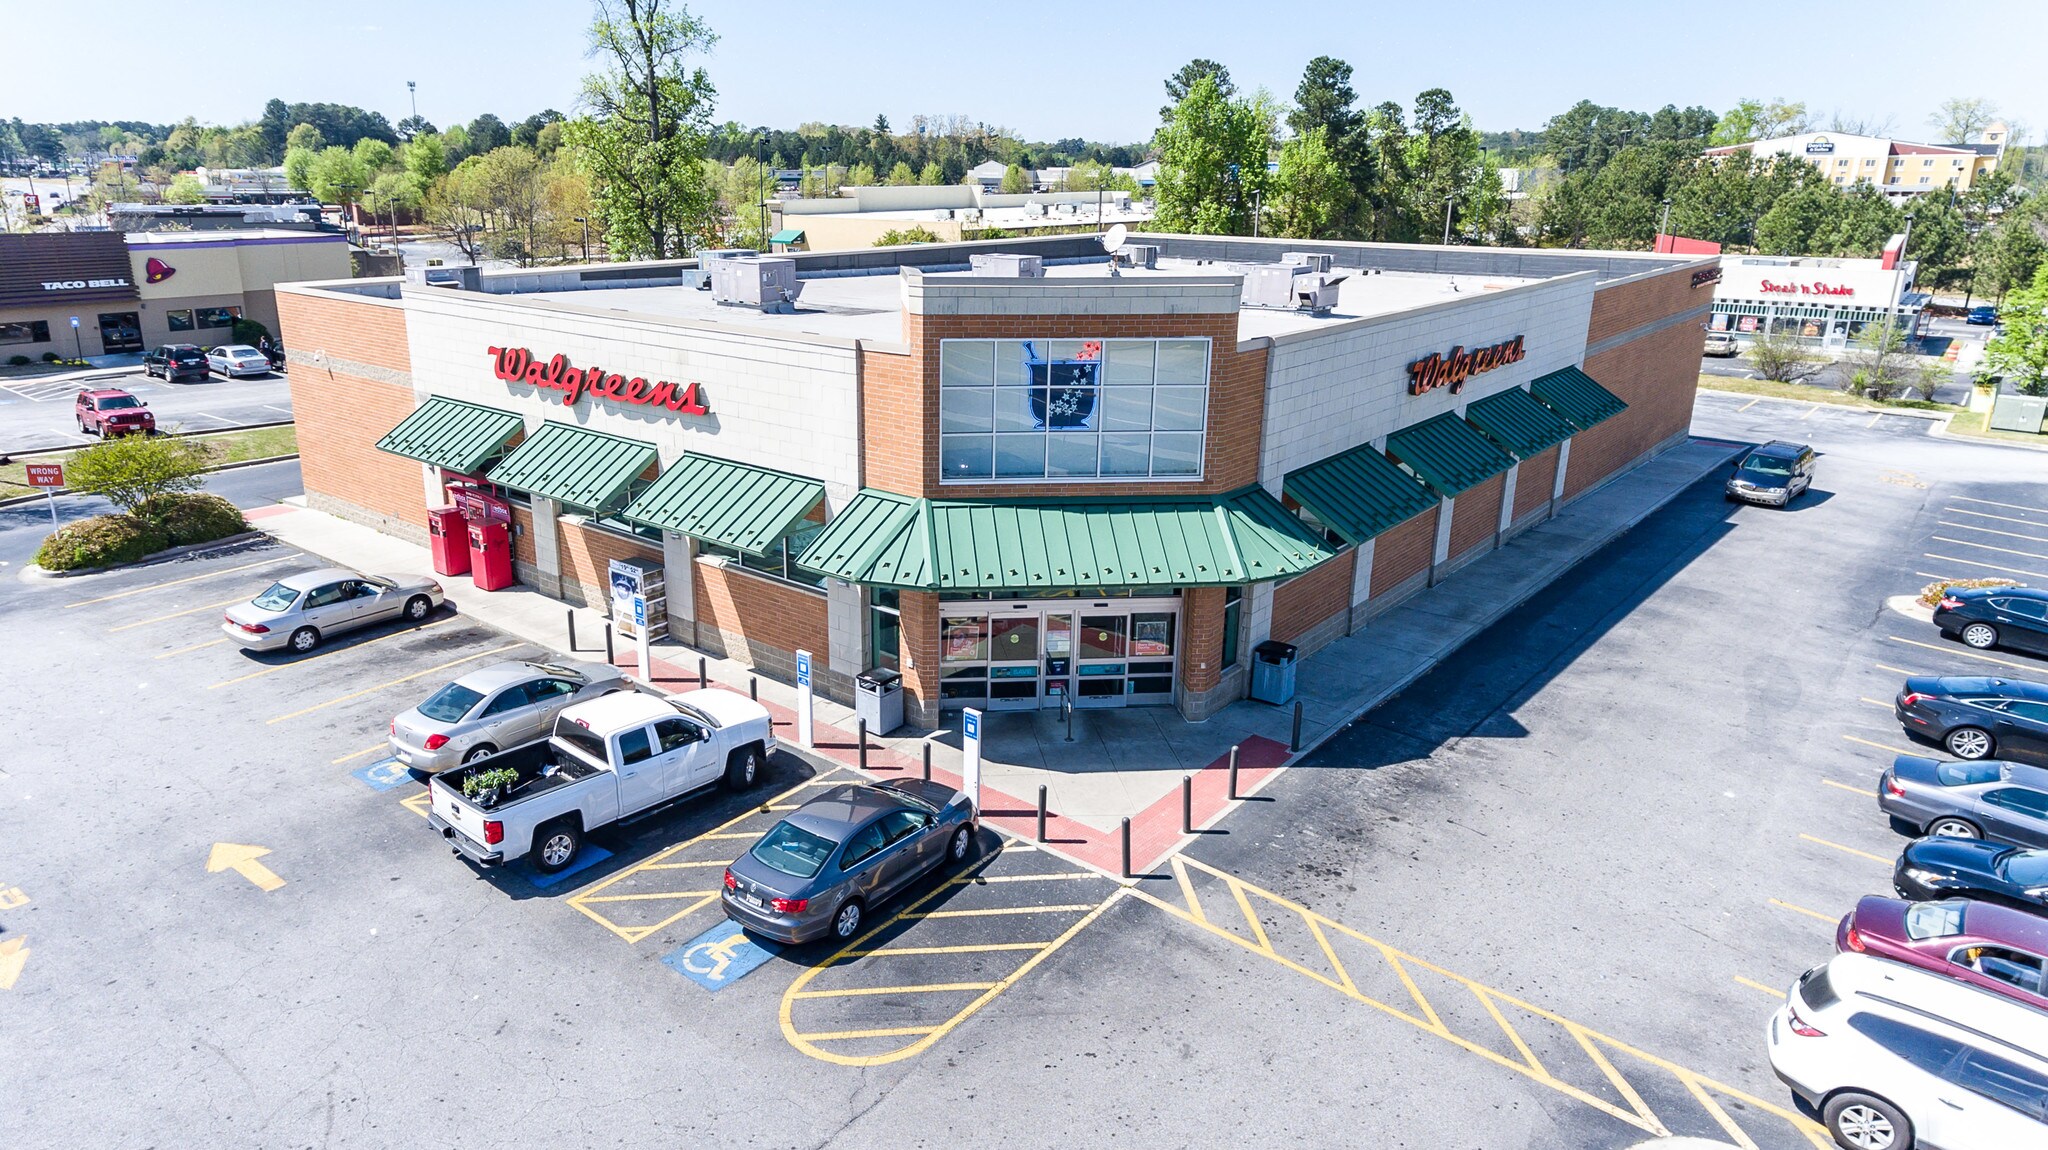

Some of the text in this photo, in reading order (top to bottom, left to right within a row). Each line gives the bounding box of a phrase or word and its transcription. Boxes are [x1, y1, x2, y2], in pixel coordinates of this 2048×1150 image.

[41, 279, 129, 290] TACO BELL
[1760, 280, 1798, 293] Steak
[1812, 282, 1855, 296] Shake
[1407, 335, 1526, 396] Walgreens
[488, 346, 709, 416] Walgreens
[30, 467, 59, 475] WRONG
